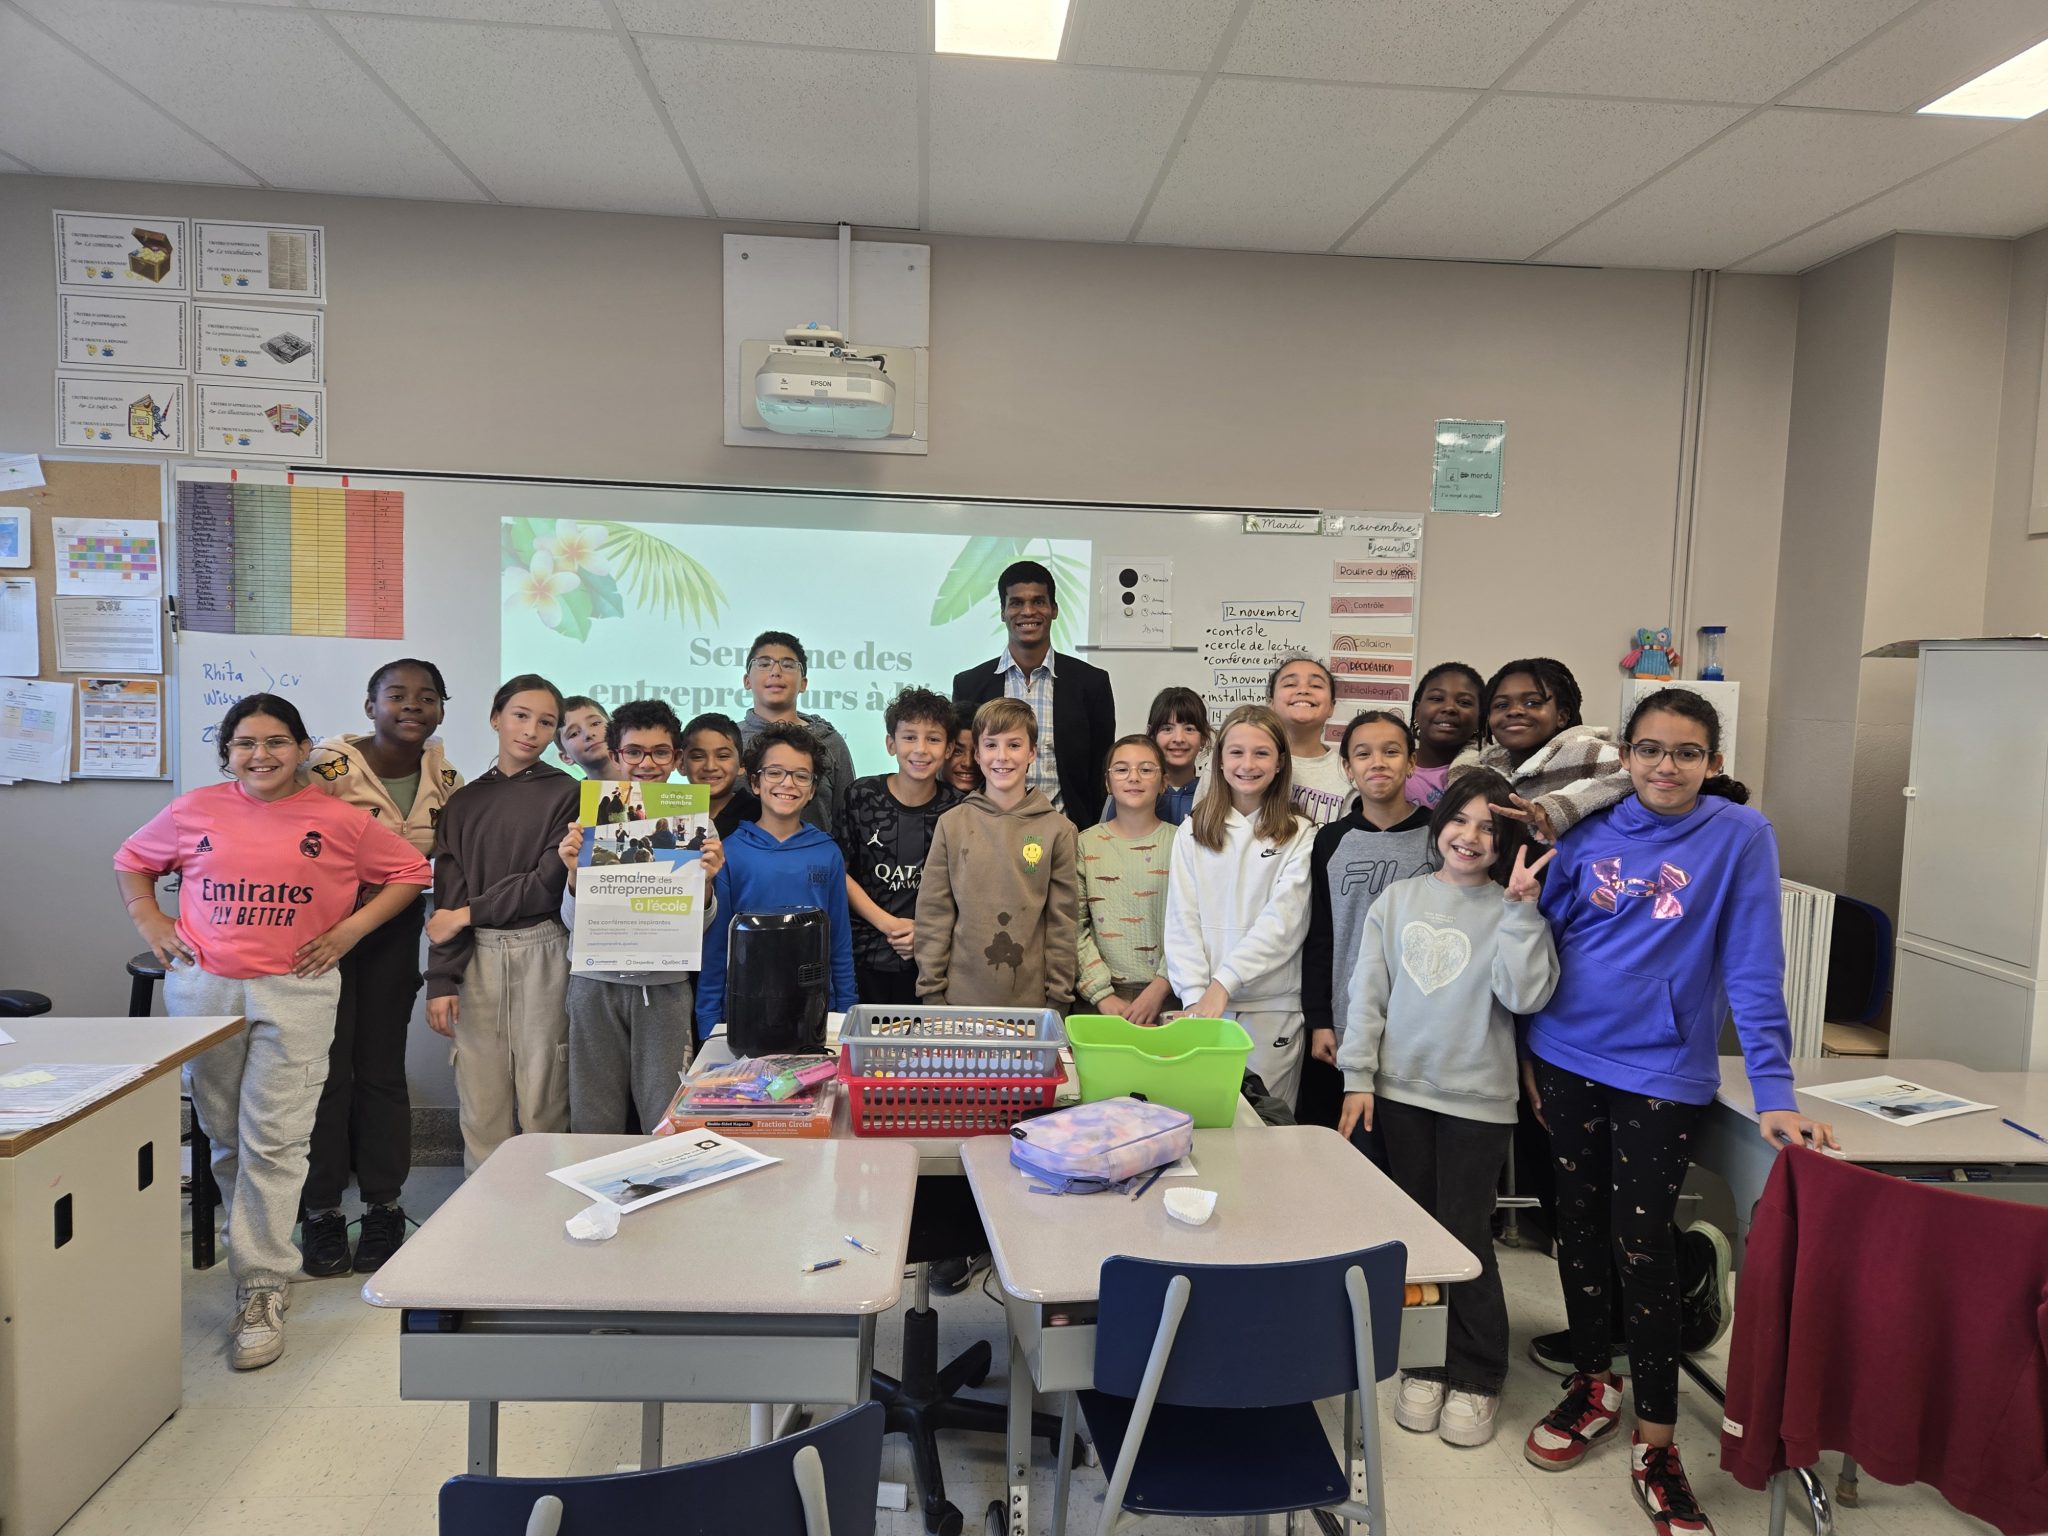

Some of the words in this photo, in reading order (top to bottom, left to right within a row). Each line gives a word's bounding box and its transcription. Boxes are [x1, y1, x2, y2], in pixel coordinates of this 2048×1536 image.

[1262, 518, 1304, 530] Mardi
[1350, 520, 1416, 534] novembre
[1376, 568, 1388, 576] du
[1226, 606, 1236, 618] 12
[1240, 606, 1299, 618] novembre
[1212, 622, 1268, 638] contrôle
[1210, 640, 1247, 650] cercle
[1249, 641, 1264, 651] de
[1268, 638, 1309, 652] lecture
[853, 641, 912, 676] des
[1208, 652, 1261, 665] conférence
[202, 660, 244, 682] Rhita
[1216, 673, 1228, 686] 13
[866, 681, 885, 712] à
[1212, 710, 1222, 723] 14
[658, 876, 672, 884] des
[203, 878, 314, 904] Emirates
[590, 884, 684, 897] entrepreneurs
[635, 899, 644, 911] à
[647, 899, 688, 912] l'école
[210, 906, 232, 925] FLY
[236, 906, 296, 926] BETTER
[757, 1120, 787, 1128] Fraction
[789, 1120, 813, 1128] Circles
